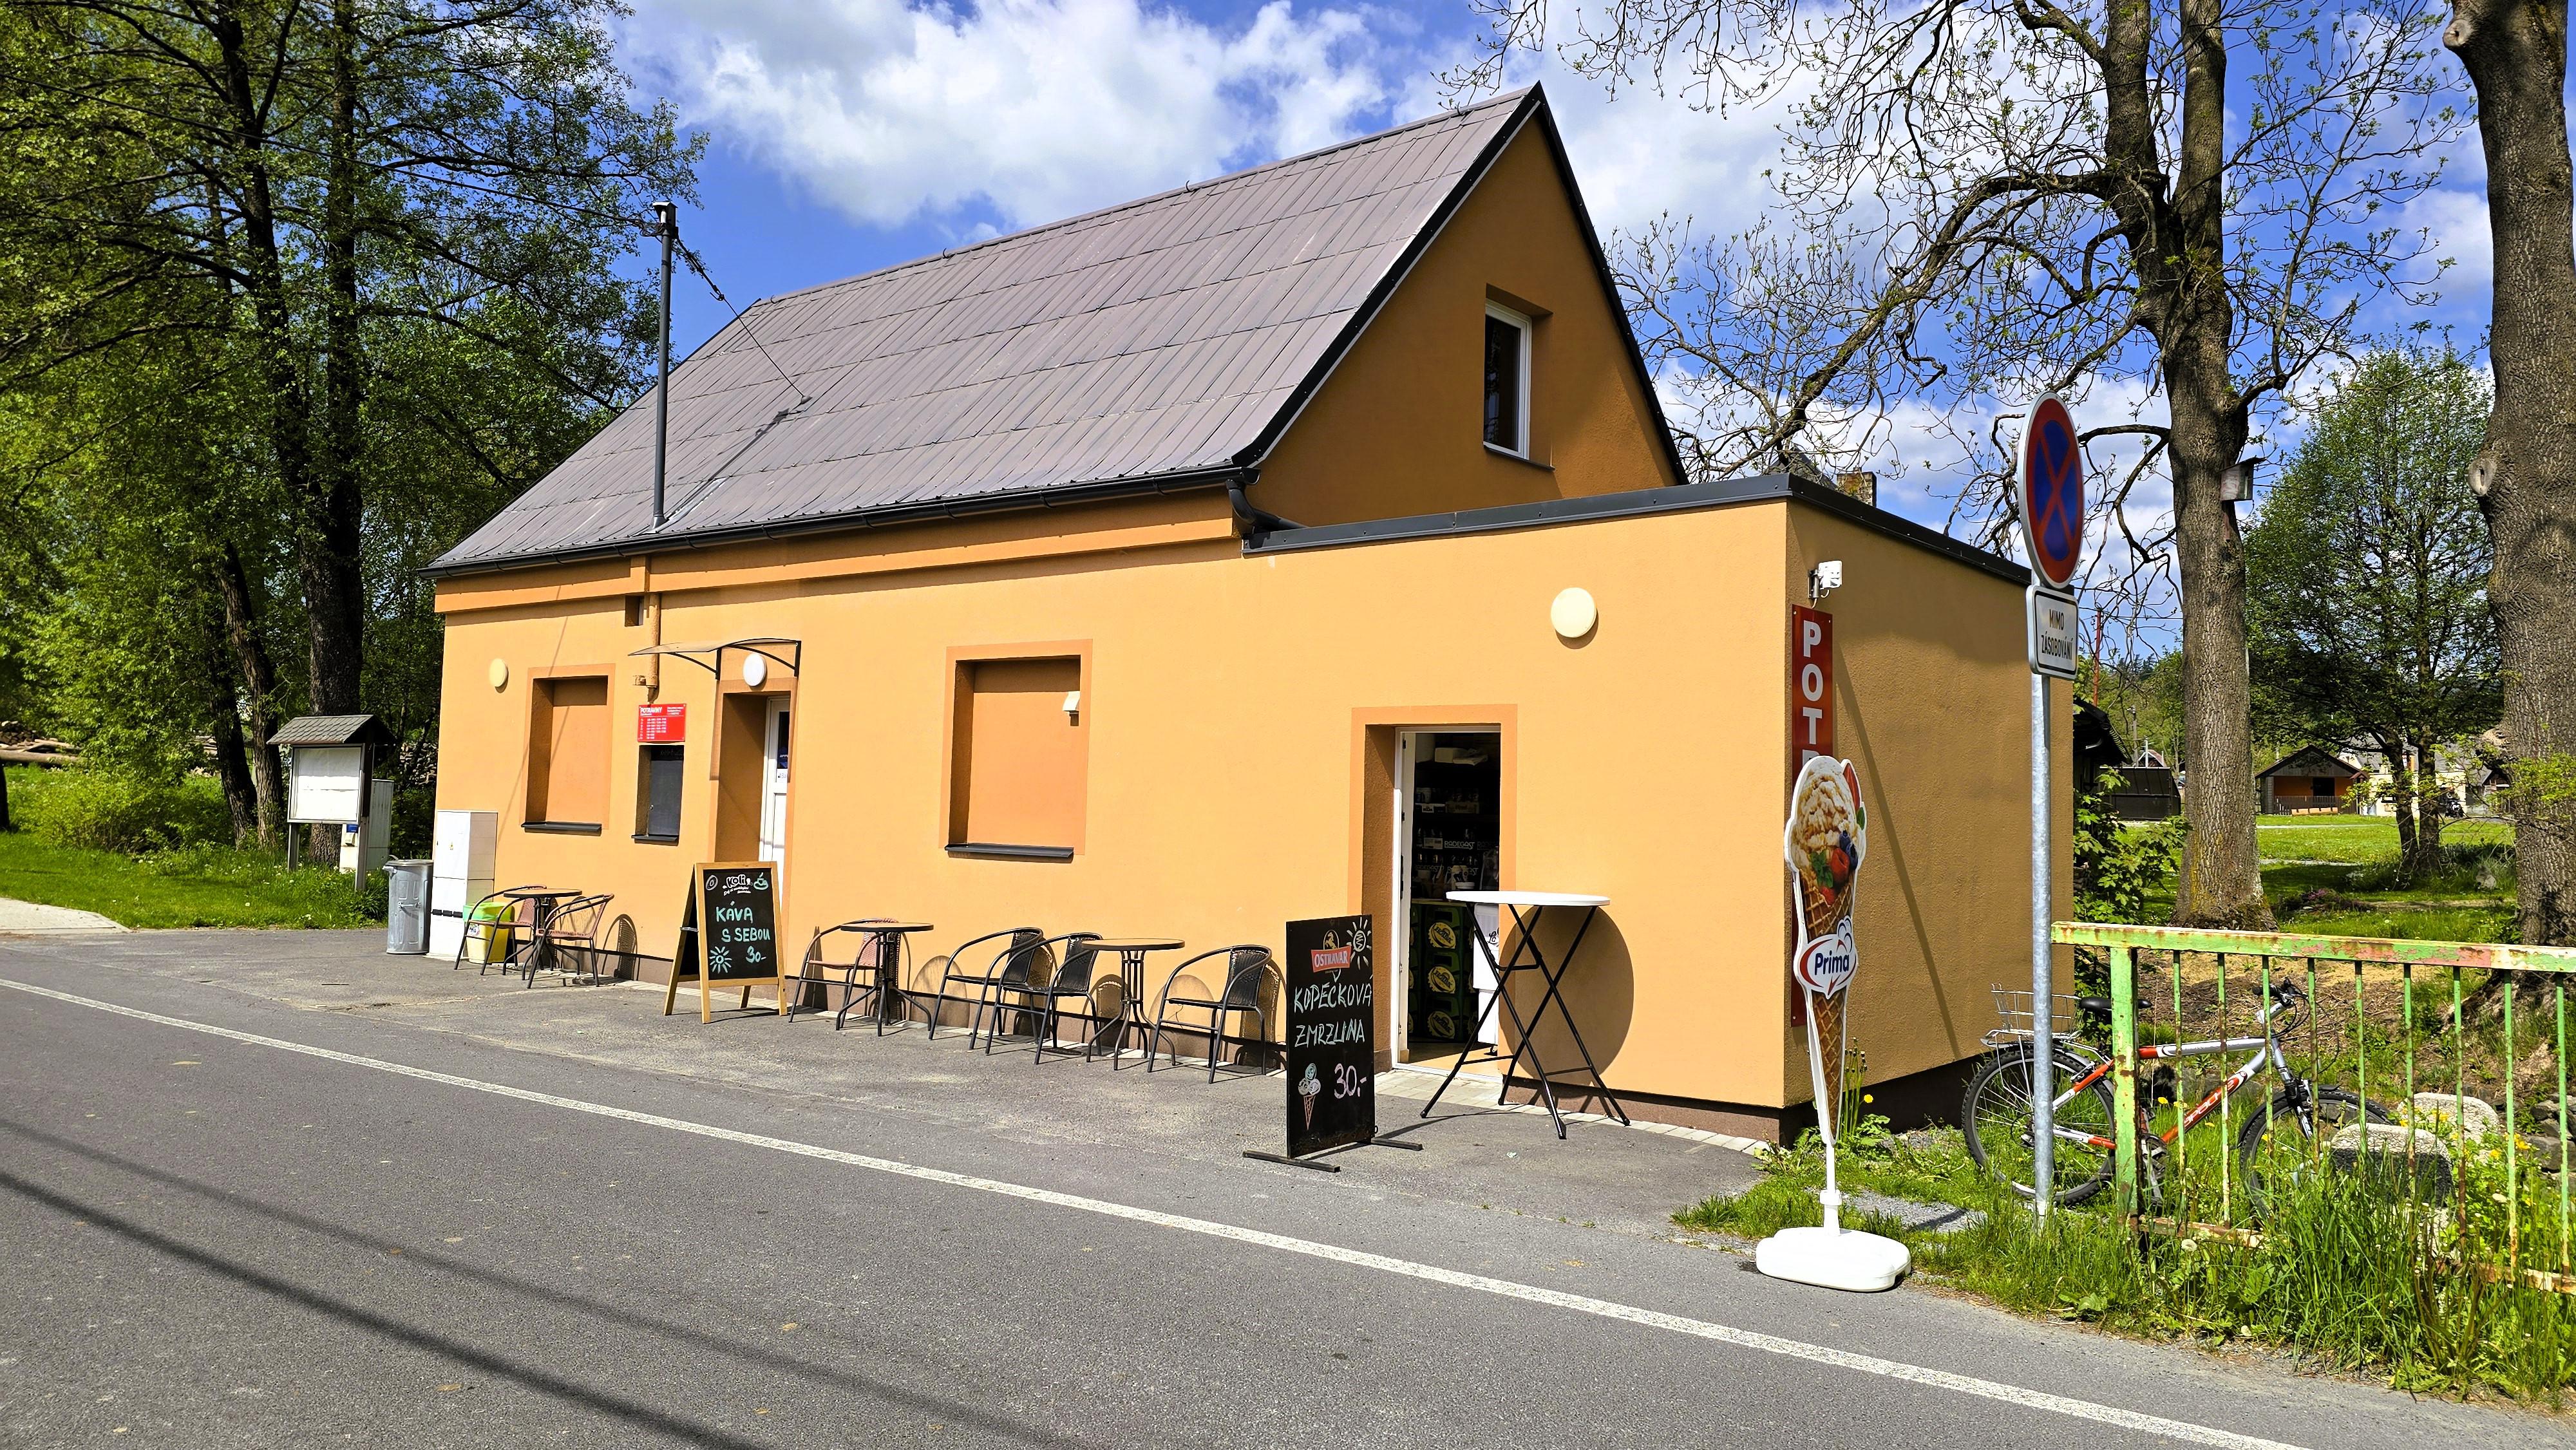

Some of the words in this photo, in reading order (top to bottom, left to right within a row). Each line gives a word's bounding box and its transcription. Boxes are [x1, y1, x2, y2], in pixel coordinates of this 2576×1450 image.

[2049, 609, 2064, 630] MIMO
[2041, 631, 2073, 660] ZÁSOBOVÁNÍ
[1444, 841, 1475, 850] RADEGAST
[716, 900, 753, 923] KÁVA
[721, 928, 731, 943] S
[734, 927, 770, 942] SEBOU
[1314, 950, 1348, 968] OSTRAVAR
[1814, 950, 1850, 975] Prima
[1294, 968, 1373, 1014] KOPEČKOVÁ
[1294, 1019, 1365, 1048] ZMRZLINA
